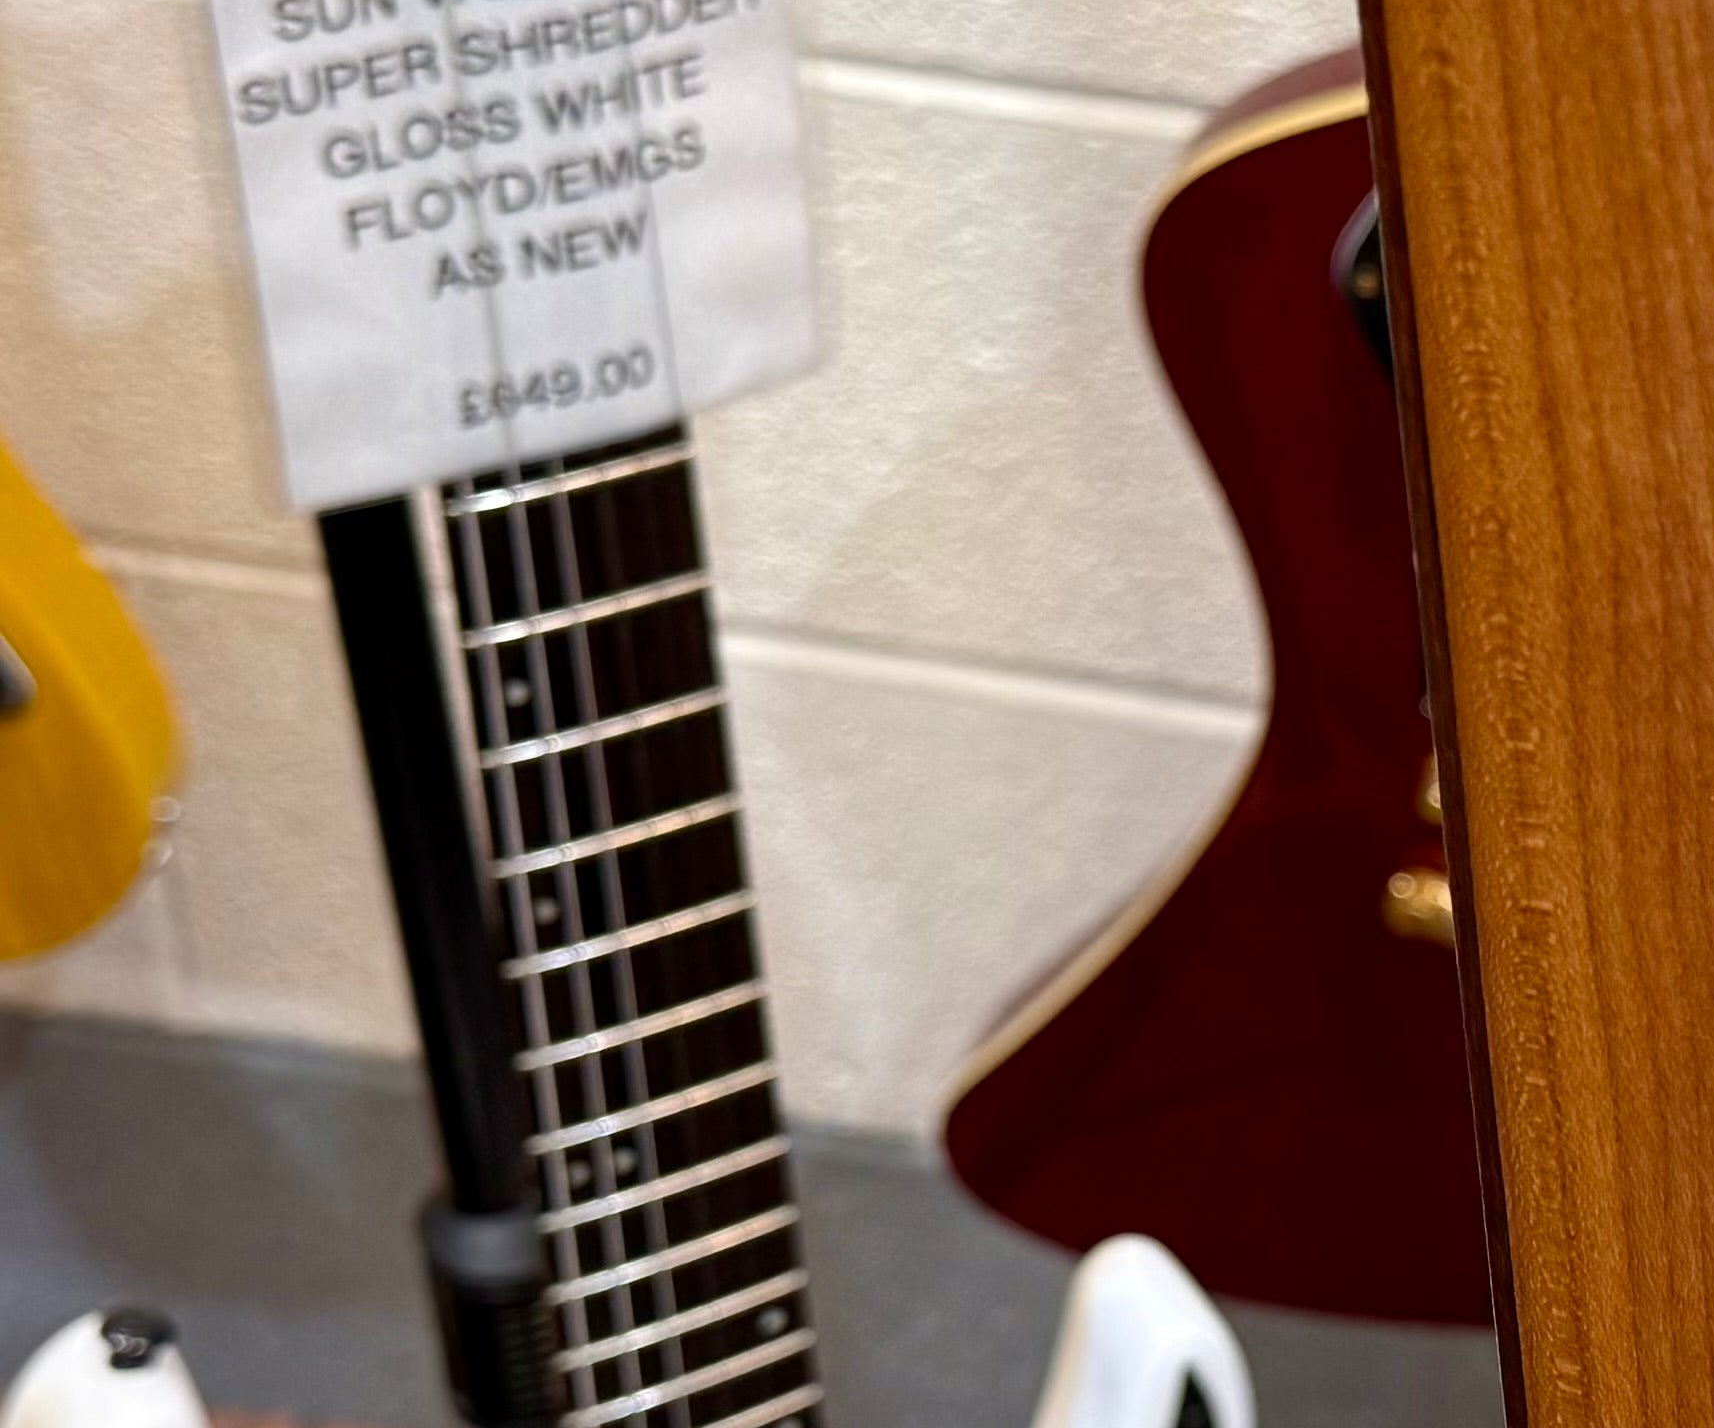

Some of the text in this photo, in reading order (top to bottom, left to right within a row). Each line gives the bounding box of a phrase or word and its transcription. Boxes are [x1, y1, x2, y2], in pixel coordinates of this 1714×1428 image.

[237, 37, 441, 127] SUPER
[322, 47, 707, 180] GLOSS WHITE
[341, 120, 707, 252] FLOYD/EMGS
[431, 212, 649, 301] AS NEW
